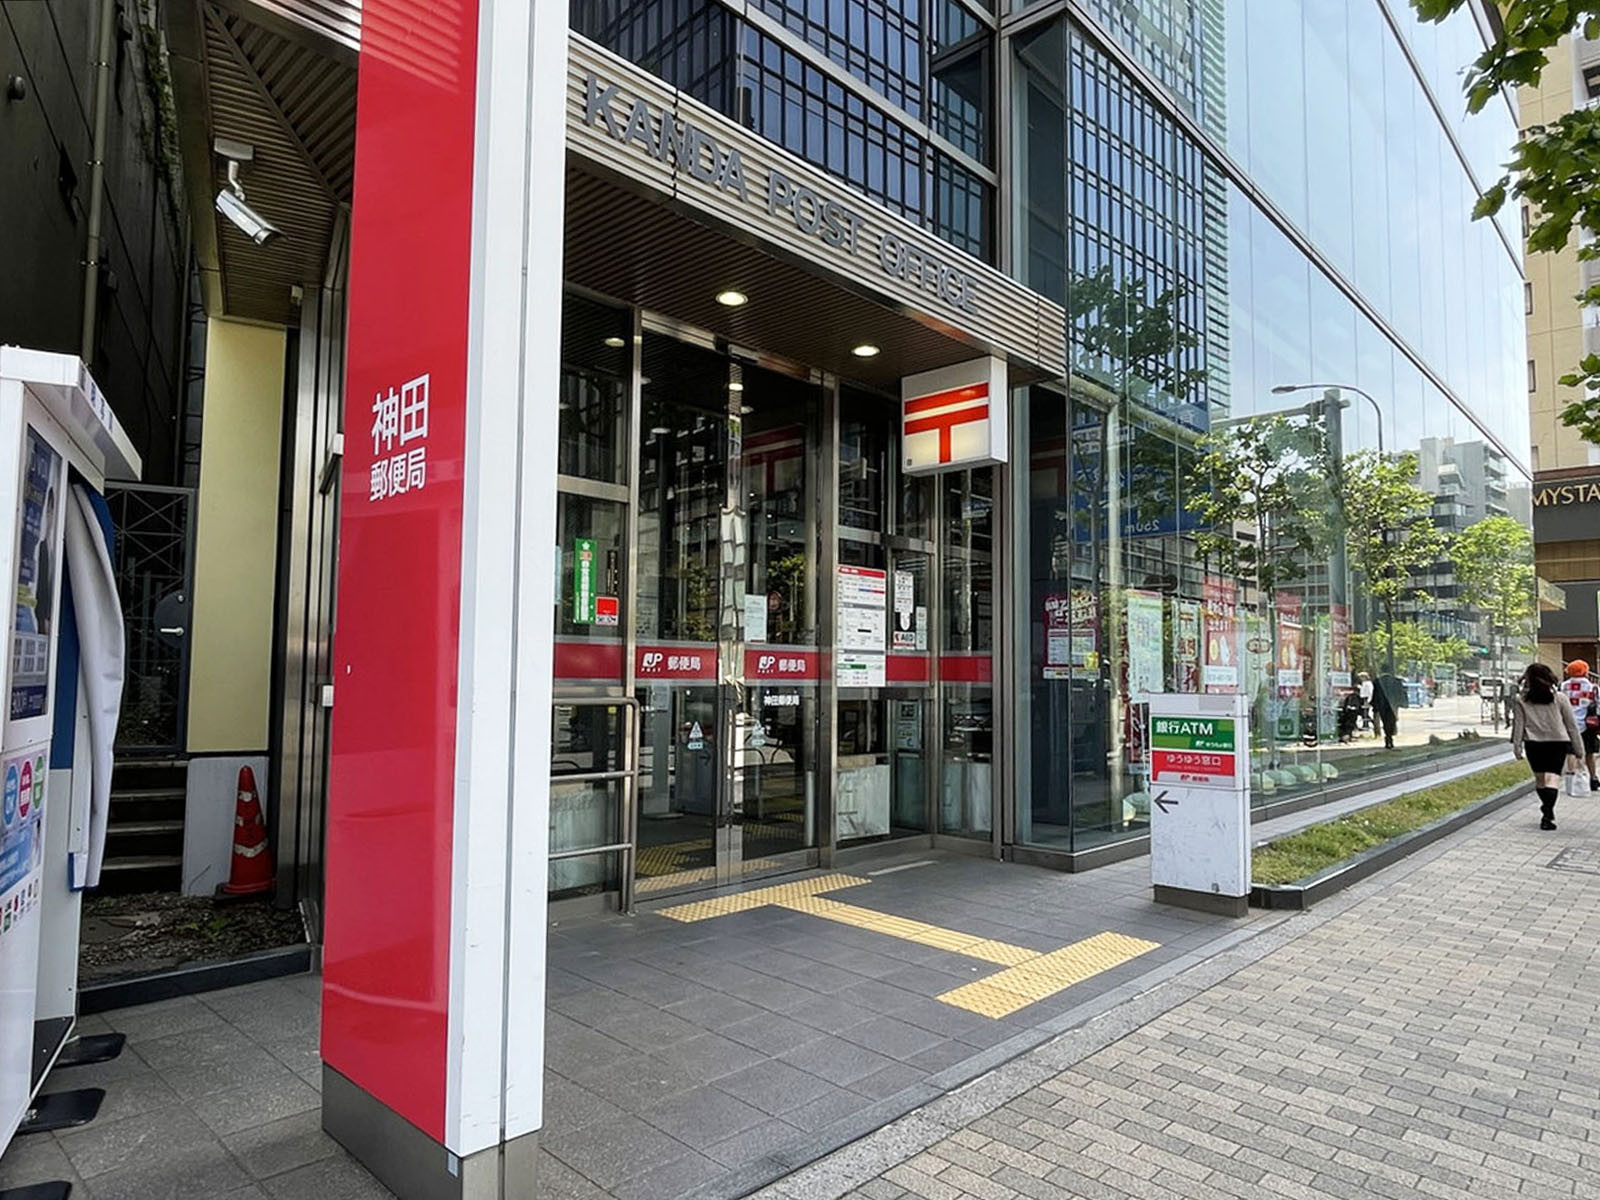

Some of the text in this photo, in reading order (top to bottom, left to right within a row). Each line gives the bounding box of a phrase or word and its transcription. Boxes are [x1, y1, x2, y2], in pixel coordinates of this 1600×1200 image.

[586, 73, 979, 316] KANDA POST OFFICE
[371, 373, 430, 455] 神田
[370, 447, 426, 501] 郵便局
[1532, 482, 1600, 507] MYSTA
[667, 655, 701, 671] 郵便局
[778, 658, 806, 672] 郵便局
[1156, 721, 1213, 736] 銀行ATM
[1166, 754, 1221, 766] ゆうゆう窓口
